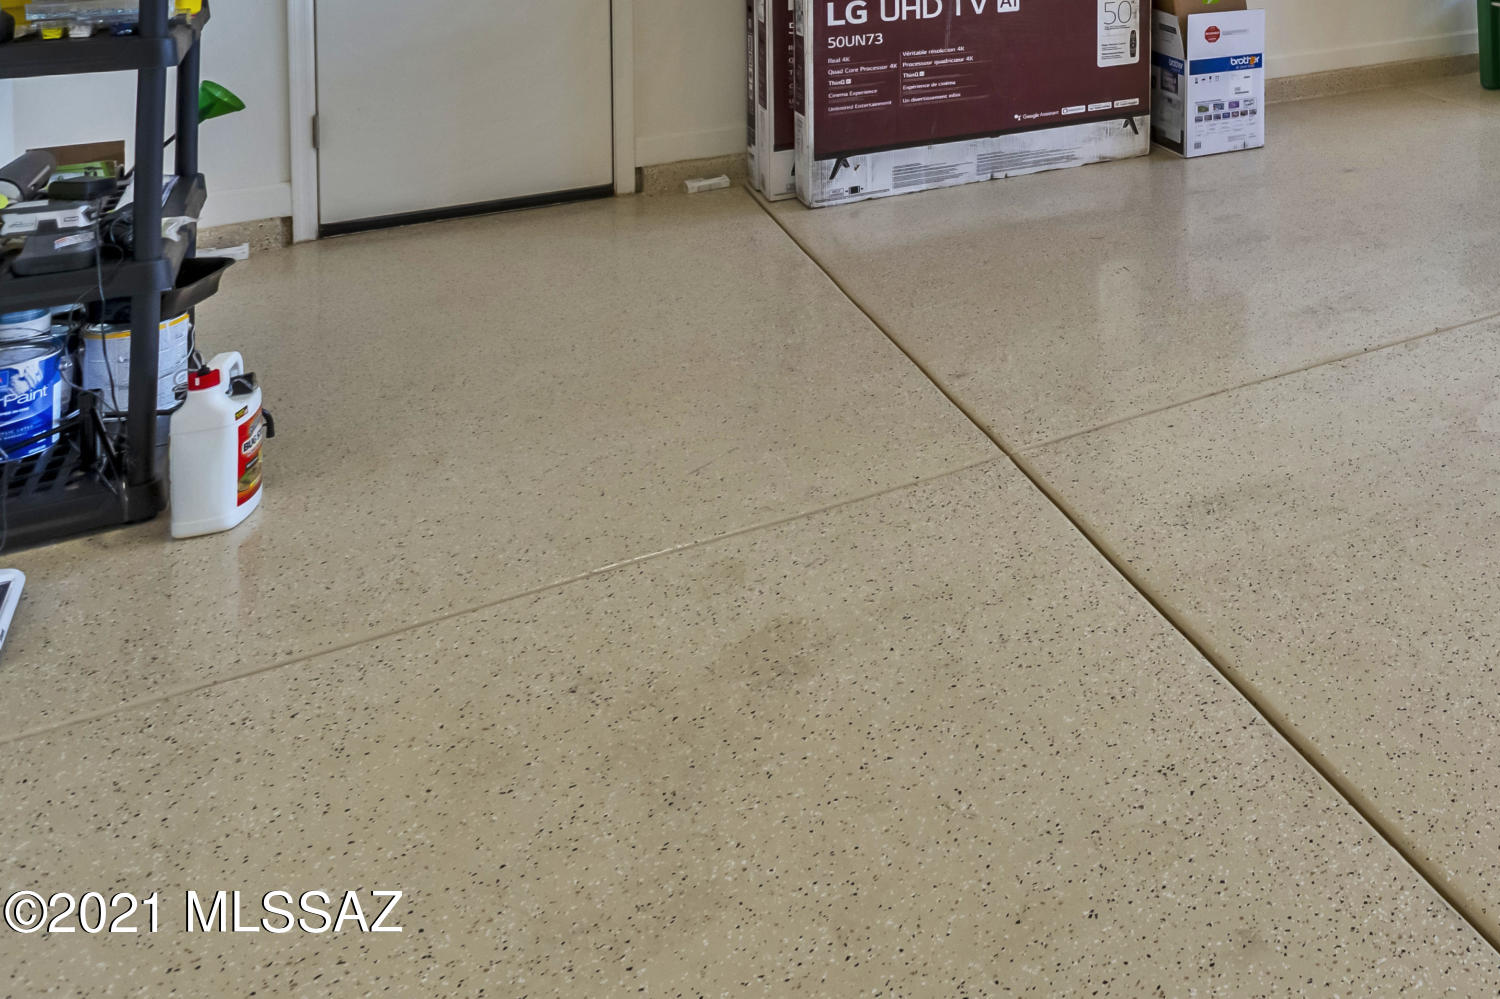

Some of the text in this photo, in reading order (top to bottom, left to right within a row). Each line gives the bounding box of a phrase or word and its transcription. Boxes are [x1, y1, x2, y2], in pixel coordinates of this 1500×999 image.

[826, 0, 868, 27] LG
[827, 32, 884, 49] 50UN73
[1230, 56, 1260, 65] brothr
[845, 66, 859, 74] Core
